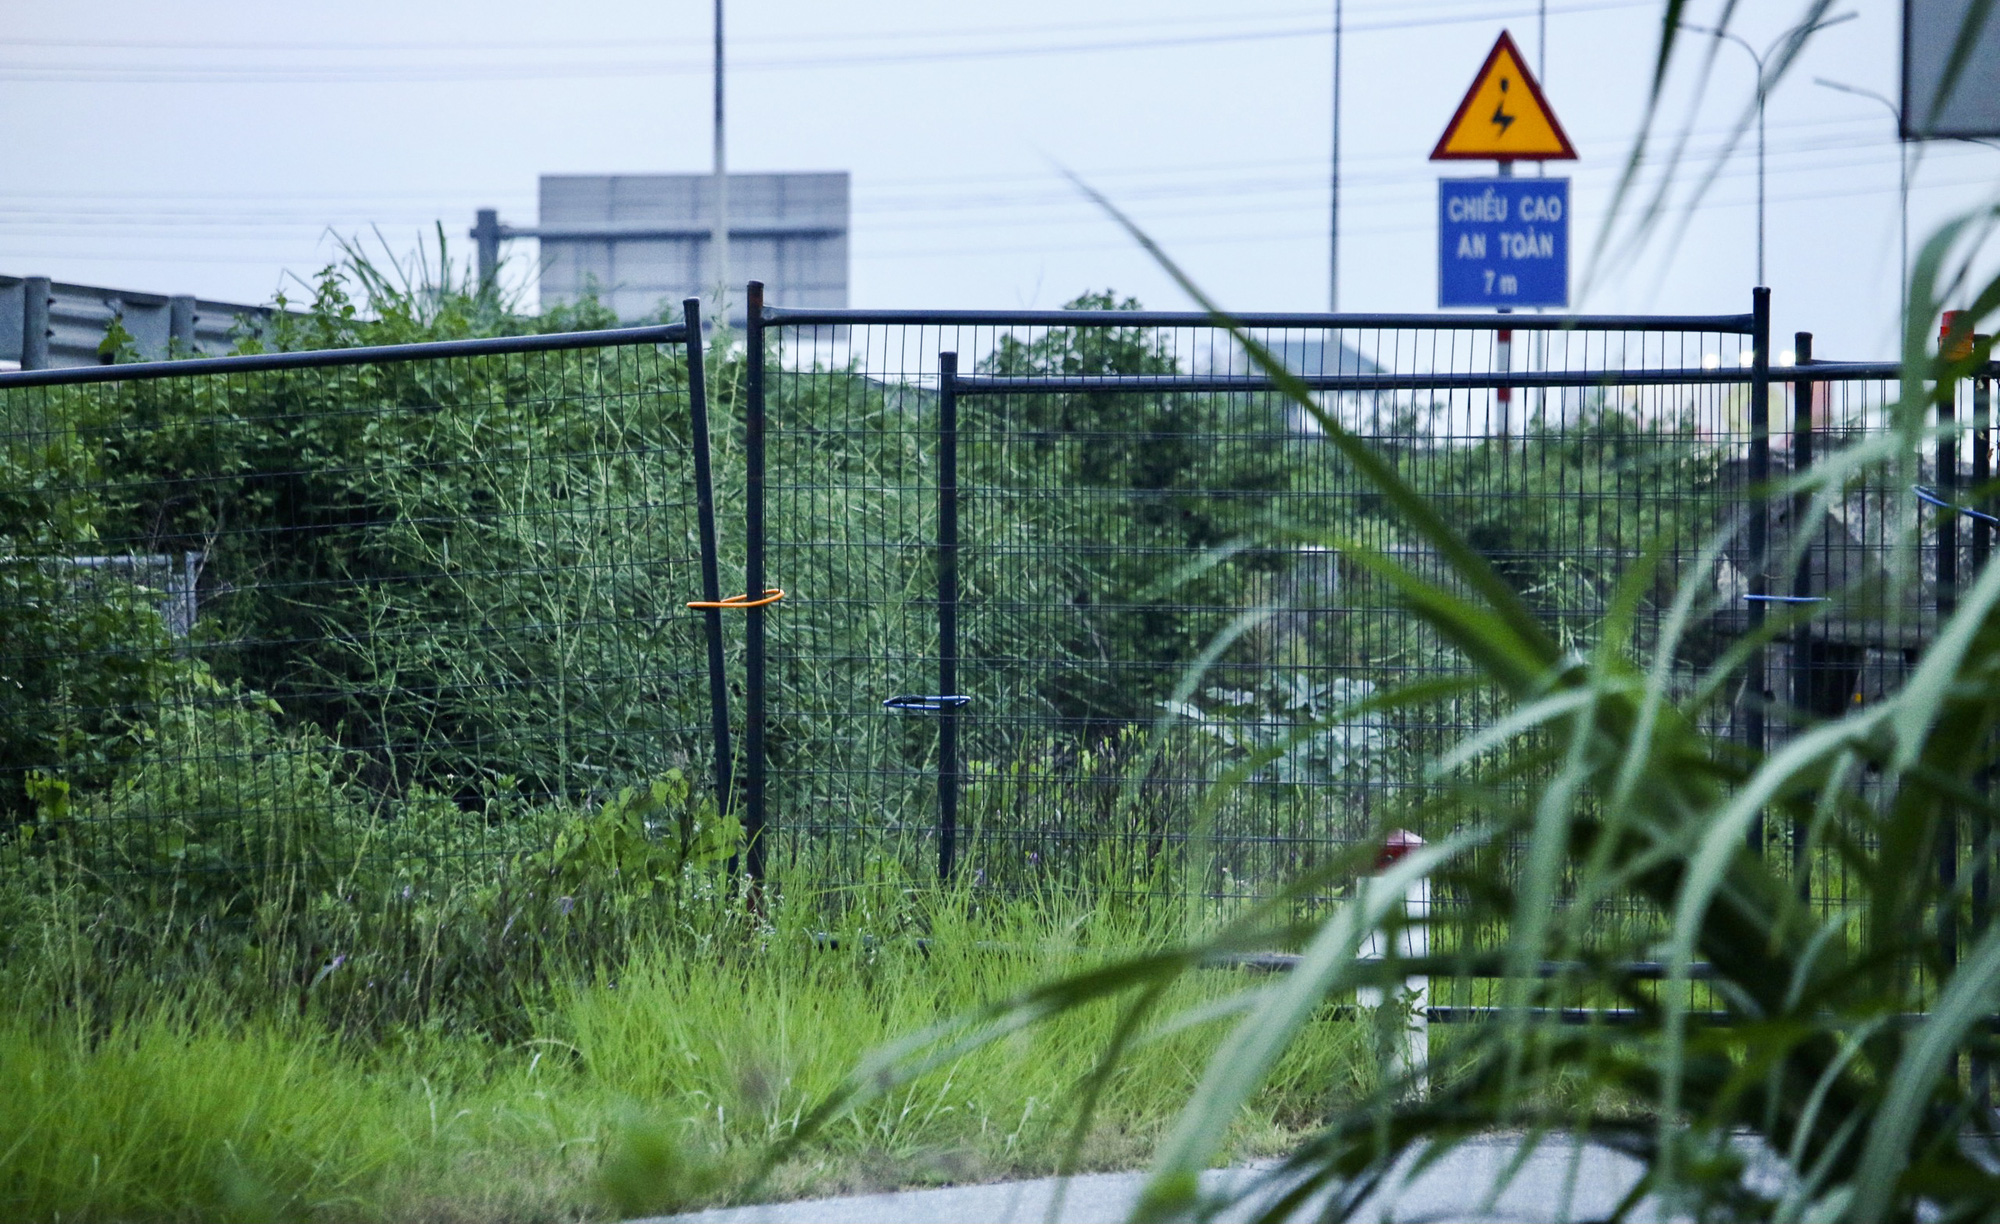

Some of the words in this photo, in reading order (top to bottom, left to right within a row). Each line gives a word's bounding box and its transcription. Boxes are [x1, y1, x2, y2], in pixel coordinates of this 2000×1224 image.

[1520, 196, 1562, 222] CAO
[1458, 234, 1487, 259] AN
[1500, 226, 1554, 260] TOÀN
